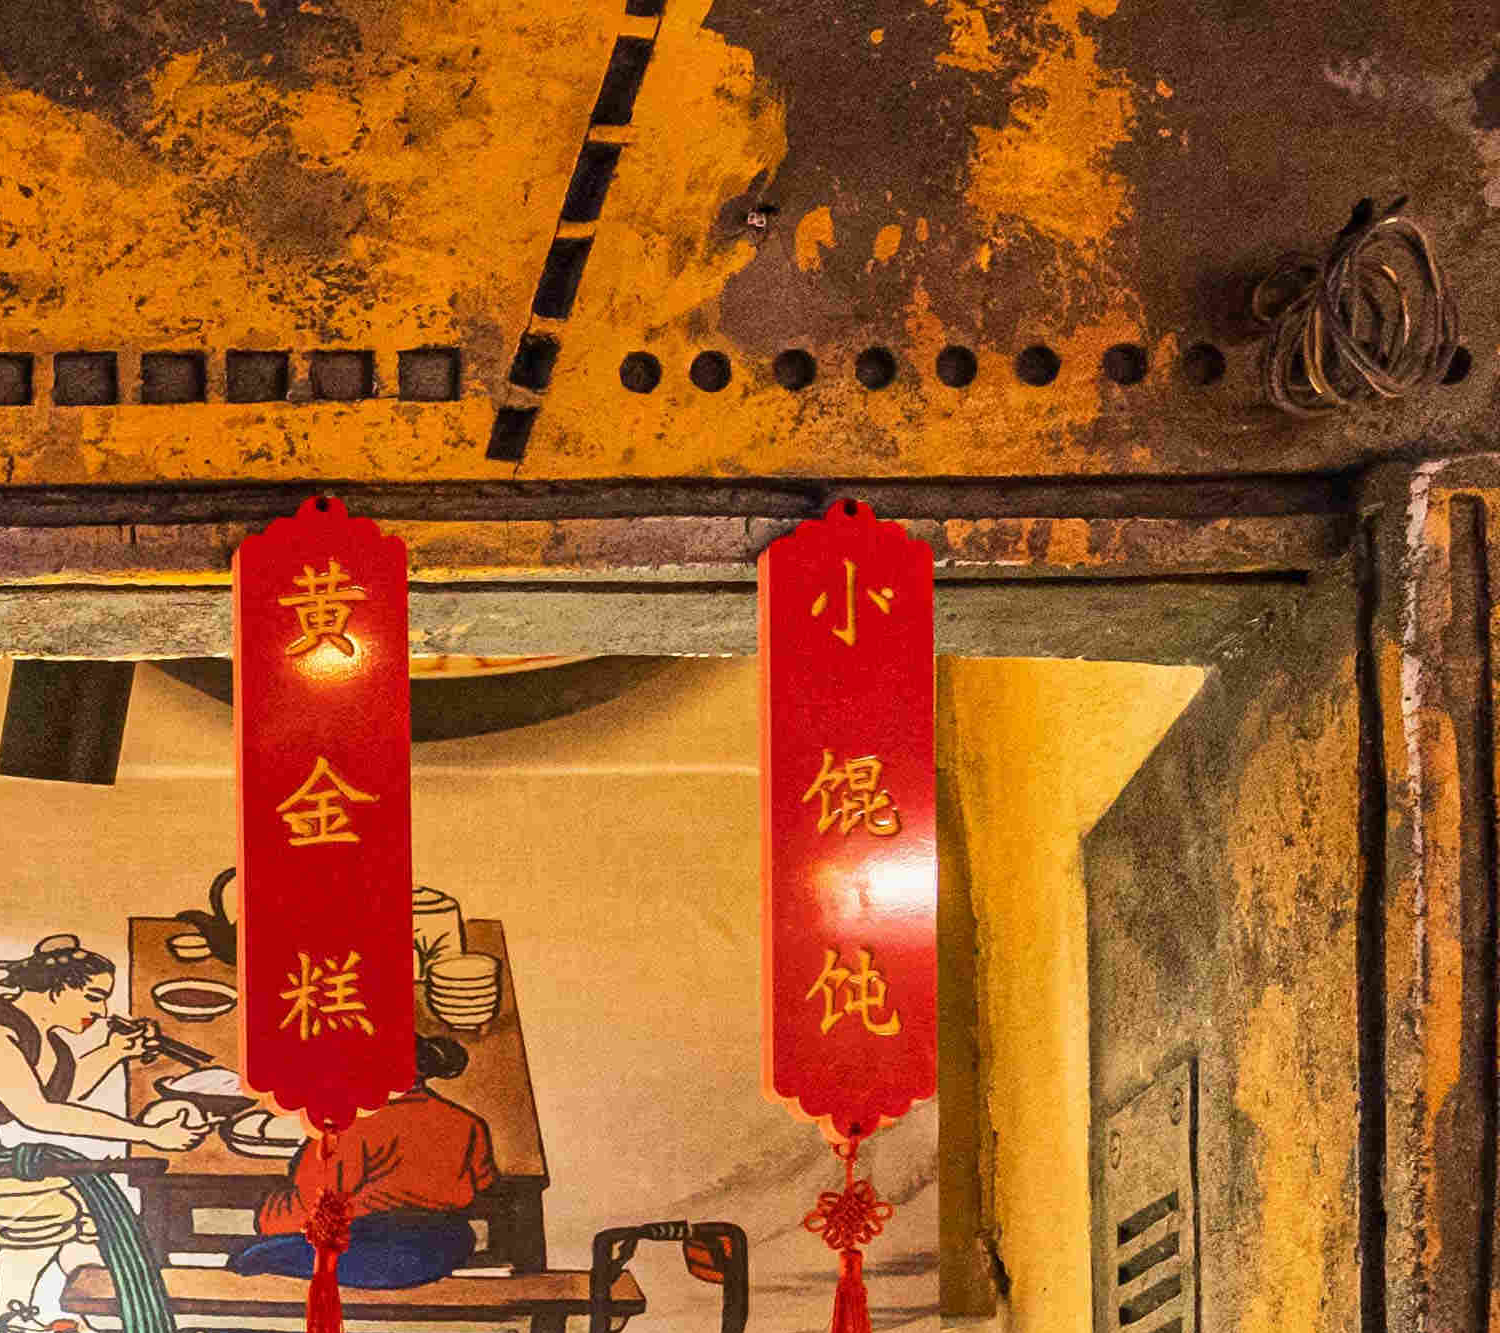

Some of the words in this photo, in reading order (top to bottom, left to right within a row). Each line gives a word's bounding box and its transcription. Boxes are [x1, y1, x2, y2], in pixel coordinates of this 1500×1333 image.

[275, 559, 381, 1042] 黄金糕
[801, 558, 902, 1039] 小馄饨
